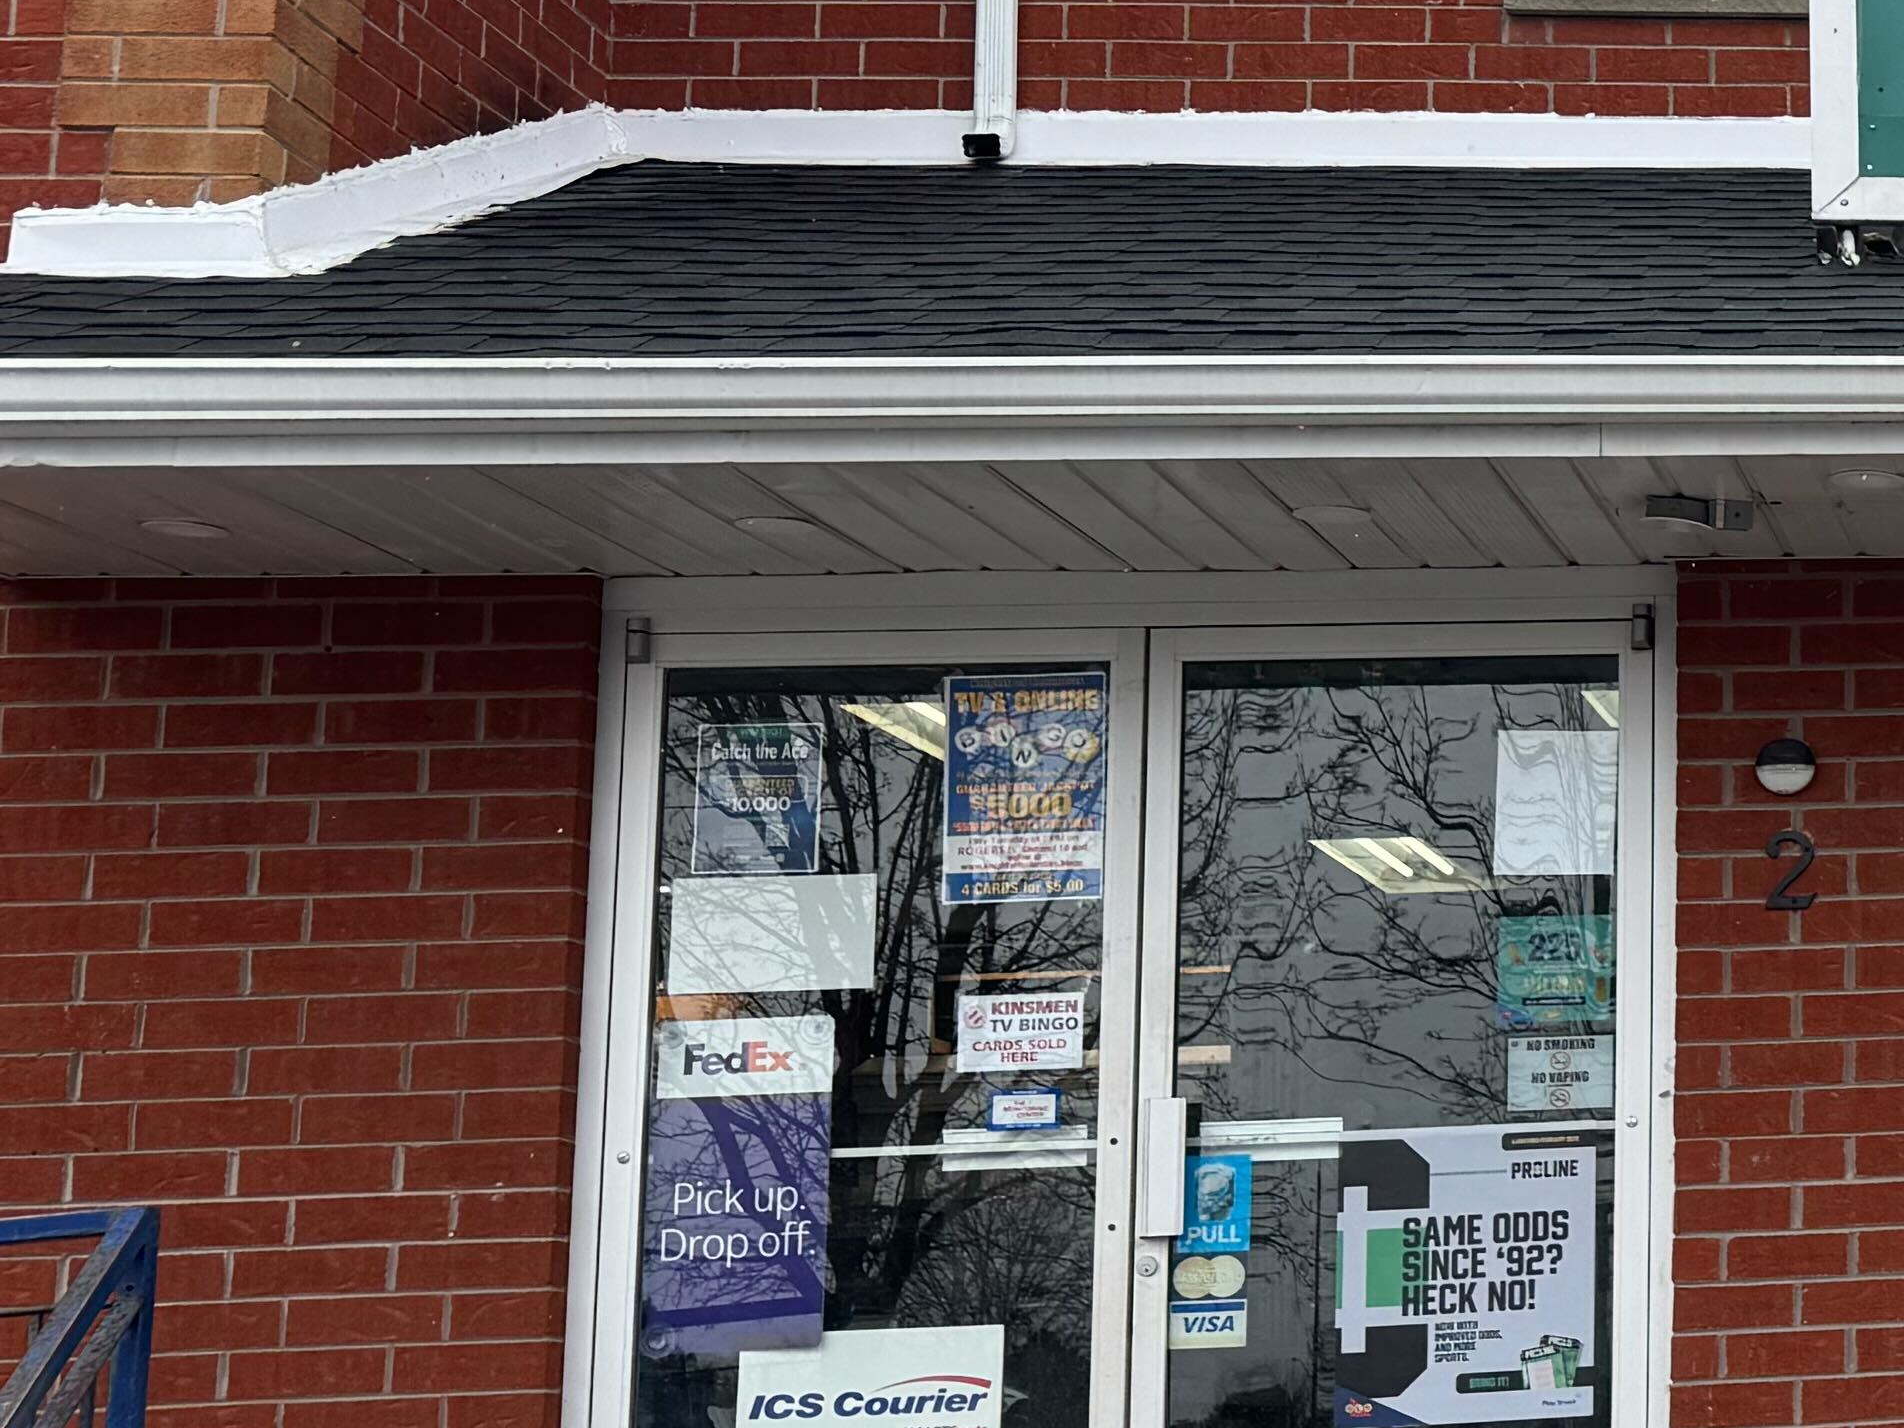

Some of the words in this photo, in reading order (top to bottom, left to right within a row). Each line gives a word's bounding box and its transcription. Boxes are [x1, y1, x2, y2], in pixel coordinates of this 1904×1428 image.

[954, 691, 985, 714] TV
[1014, 689, 1100, 713] ONLINE
[711, 742, 751, 761] Catch
[755, 742, 778, 760] the
[781, 741, 809, 760] Ace
[1766, 830, 1818, 911] 2
[961, 884, 971, 896] 4
[973, 881, 1019, 896] CARDS
[990, 999, 1079, 1016] KINSMEN
[990, 1018, 1013, 1033] TV
[1018, 1016, 1079, 1033] BINGO
[972, 1039, 1023, 1053] CARDS
[1028, 1038, 1067, 1051] SOLD
[1526, 1040, 1542, 1052] NO
[1543, 1038, 1596, 1051] SMOKING
[683, 1040, 796, 1076] FedEx
[1000, 1051, 1039, 1063] HERE
[1531, 1073, 1547, 1084] NO
[1548, 1071, 1590, 1084] VAPING
[1511, 1159, 1580, 1180] PROLINE
[673, 1179, 744, 1217] Pick
[754, 1185, 806, 1221] up.
[1186, 1224, 1242, 1244] PULL
[1402, 1213, 1484, 1249] SAME
[1492, 1209, 1570, 1244] ODDS
[659, 1228, 749, 1269] Drop
[757, 1219, 816, 1258] off.
[1402, 1247, 1487, 1283] SINCE
[1401, 1282, 1478, 1317] HECK
[1487, 1279, 1536, 1313] NO!
[1183, 1315, 1235, 1334] VISA
[748, 1392, 825, 1421] ICS
[833, 1387, 989, 1418] Courier
